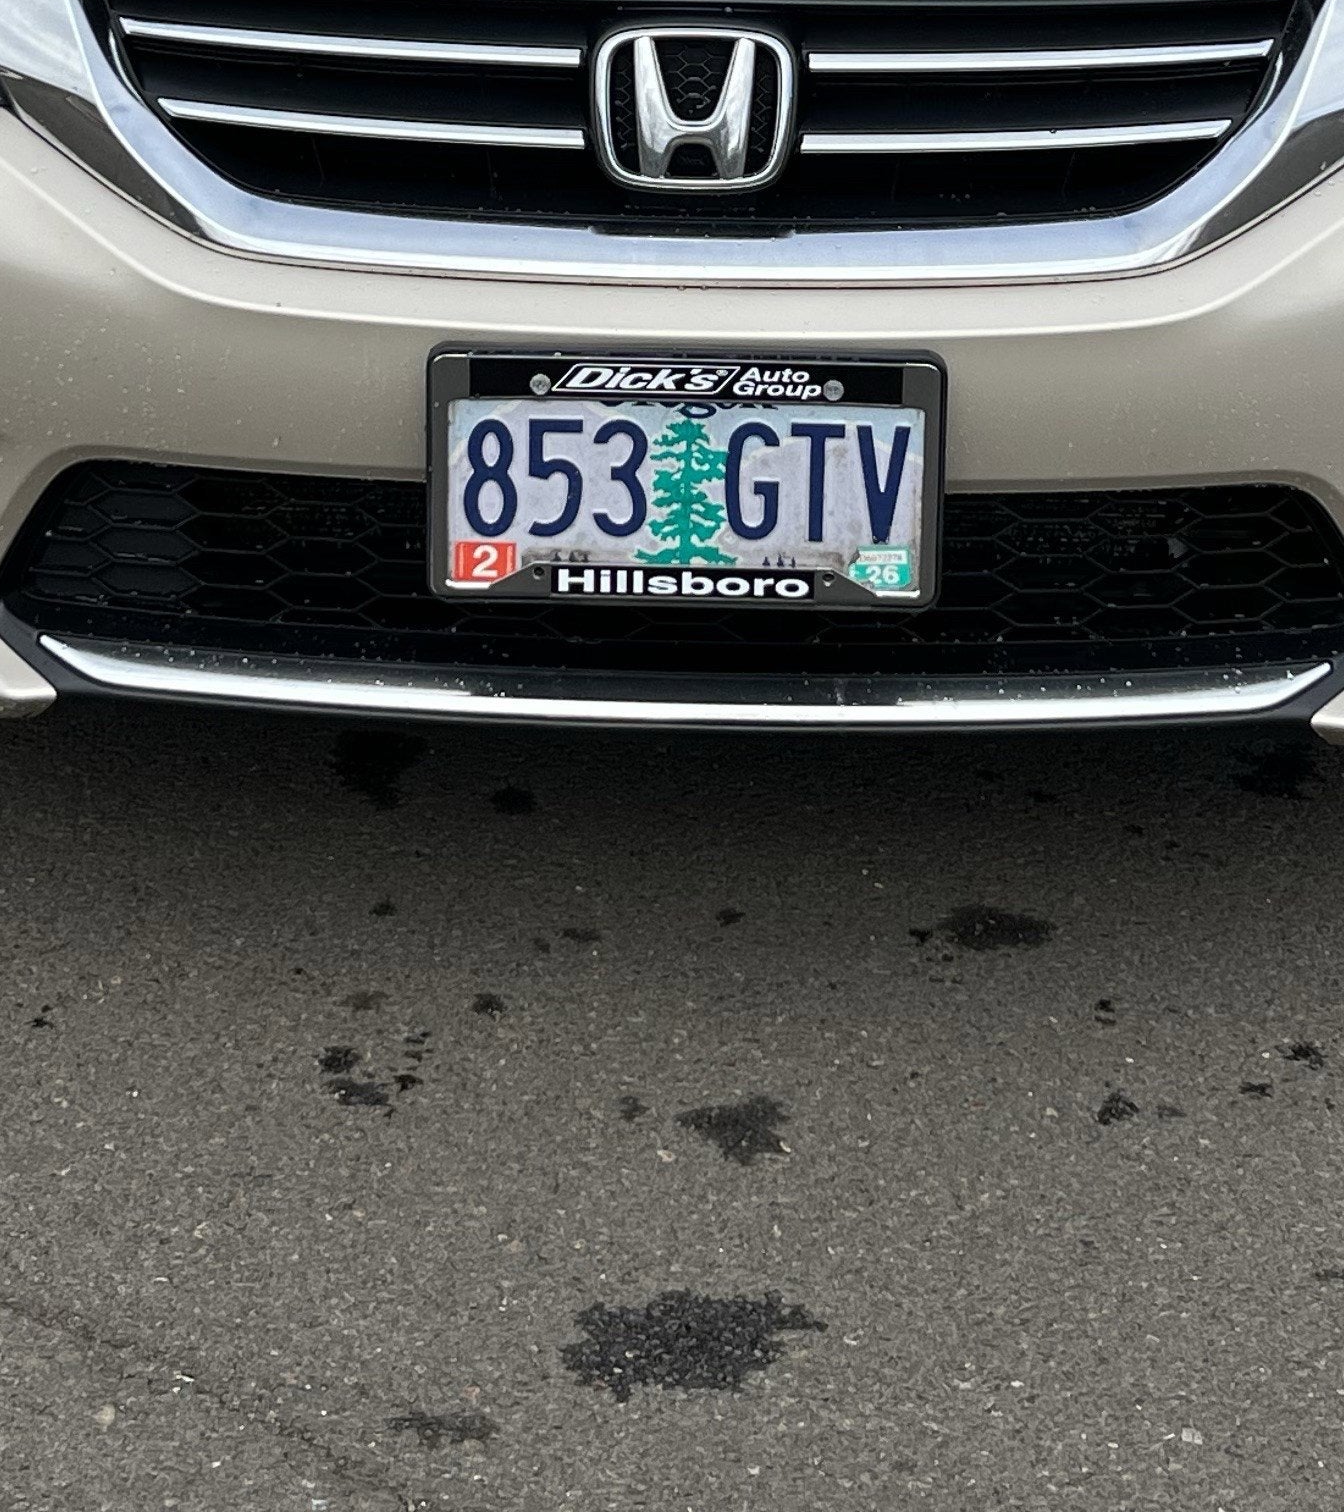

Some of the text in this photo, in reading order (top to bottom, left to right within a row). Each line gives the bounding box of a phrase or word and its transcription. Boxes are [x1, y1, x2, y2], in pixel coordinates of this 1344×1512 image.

[738, 366, 811, 384] Auto
[731, 380, 822, 401] Group
[462, 417, 912, 545] 853 GTV
[471, 544, 499, 578] 2
[556, 567, 810, 599] Hillsboro
[865, 564, 901, 585] 26
